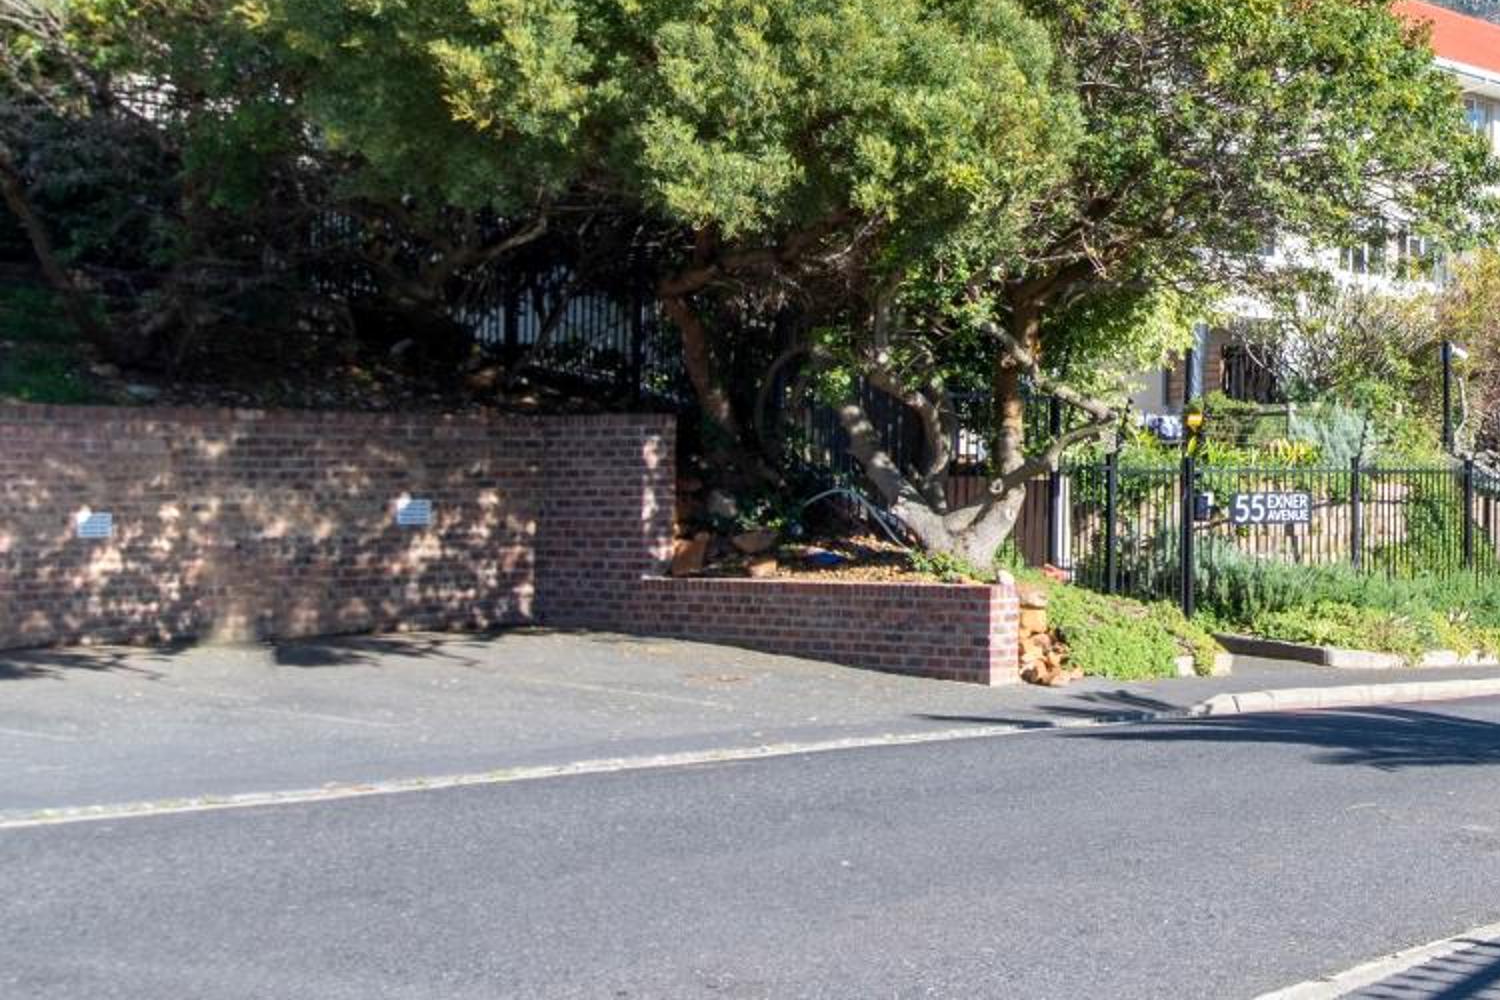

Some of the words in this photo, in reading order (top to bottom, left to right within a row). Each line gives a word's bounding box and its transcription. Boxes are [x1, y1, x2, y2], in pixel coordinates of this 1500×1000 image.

[1235, 494, 1265, 522] 55
[1267, 494, 1308, 508] EXNER
[1267, 510, 1309, 520] AVENUE
